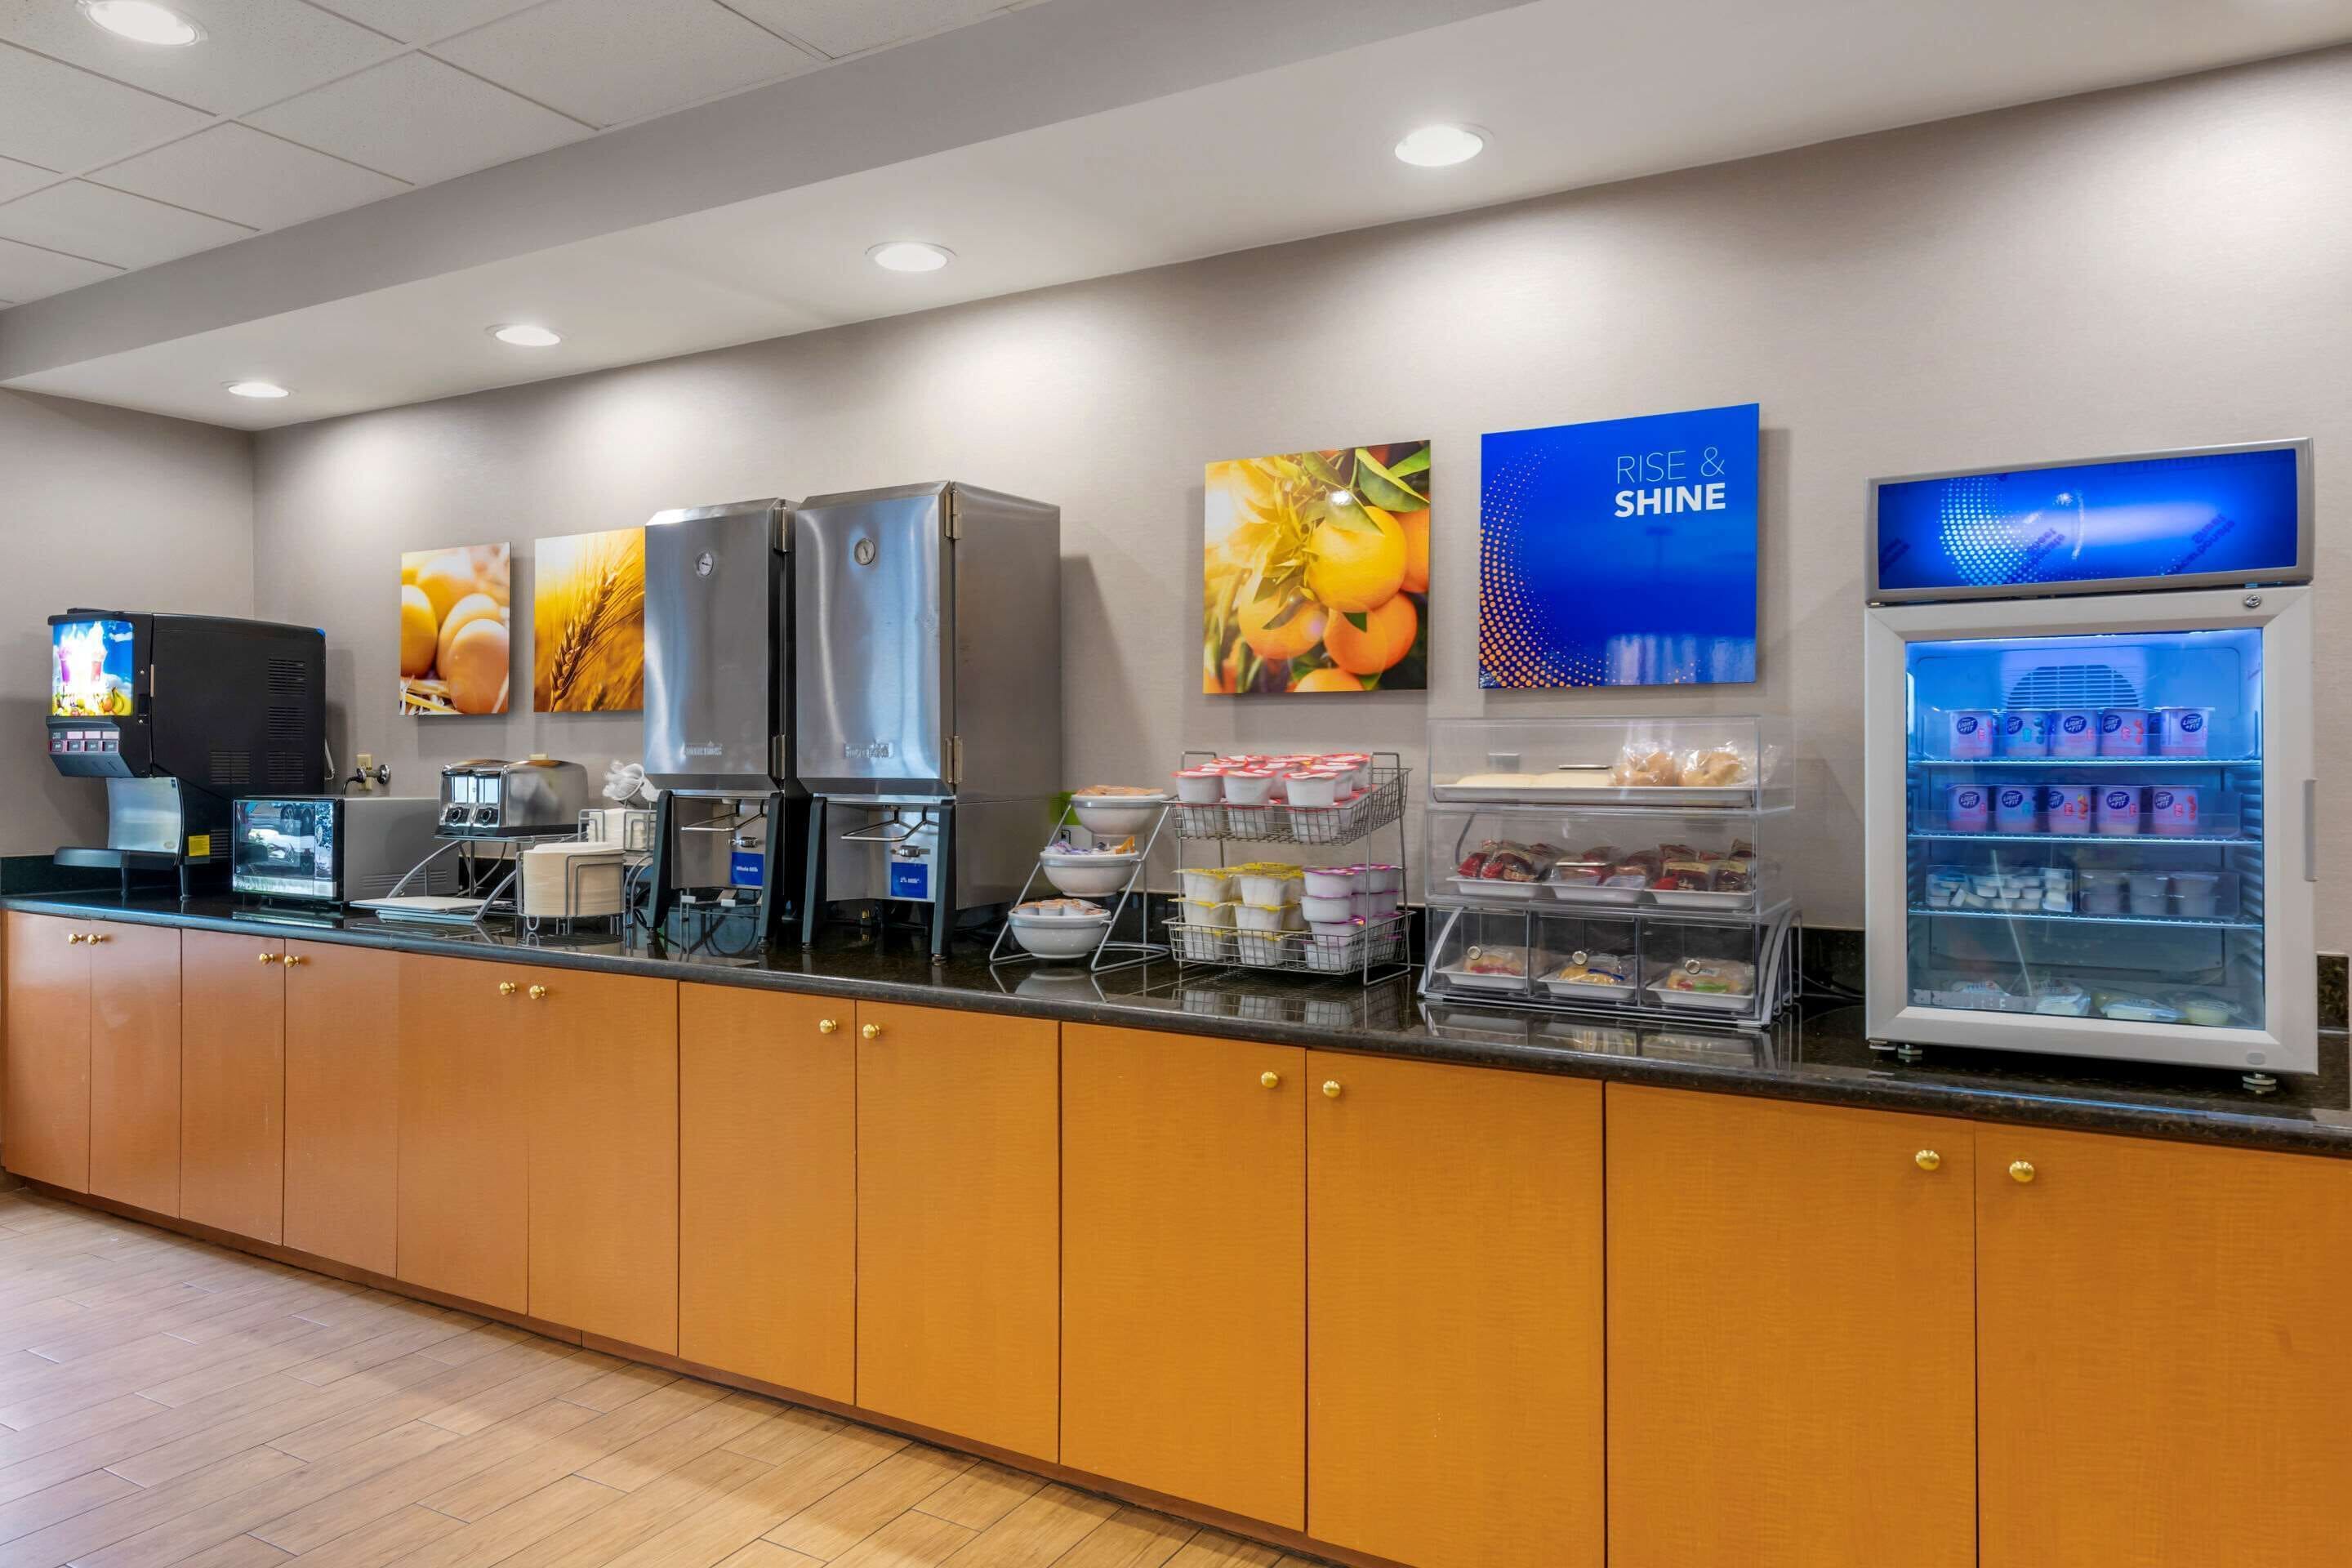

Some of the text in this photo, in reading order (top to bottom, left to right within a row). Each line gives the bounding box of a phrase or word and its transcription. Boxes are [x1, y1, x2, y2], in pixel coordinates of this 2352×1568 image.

[1617, 446, 1725, 483] RISE &
[1615, 483, 1726, 518] SHINE
